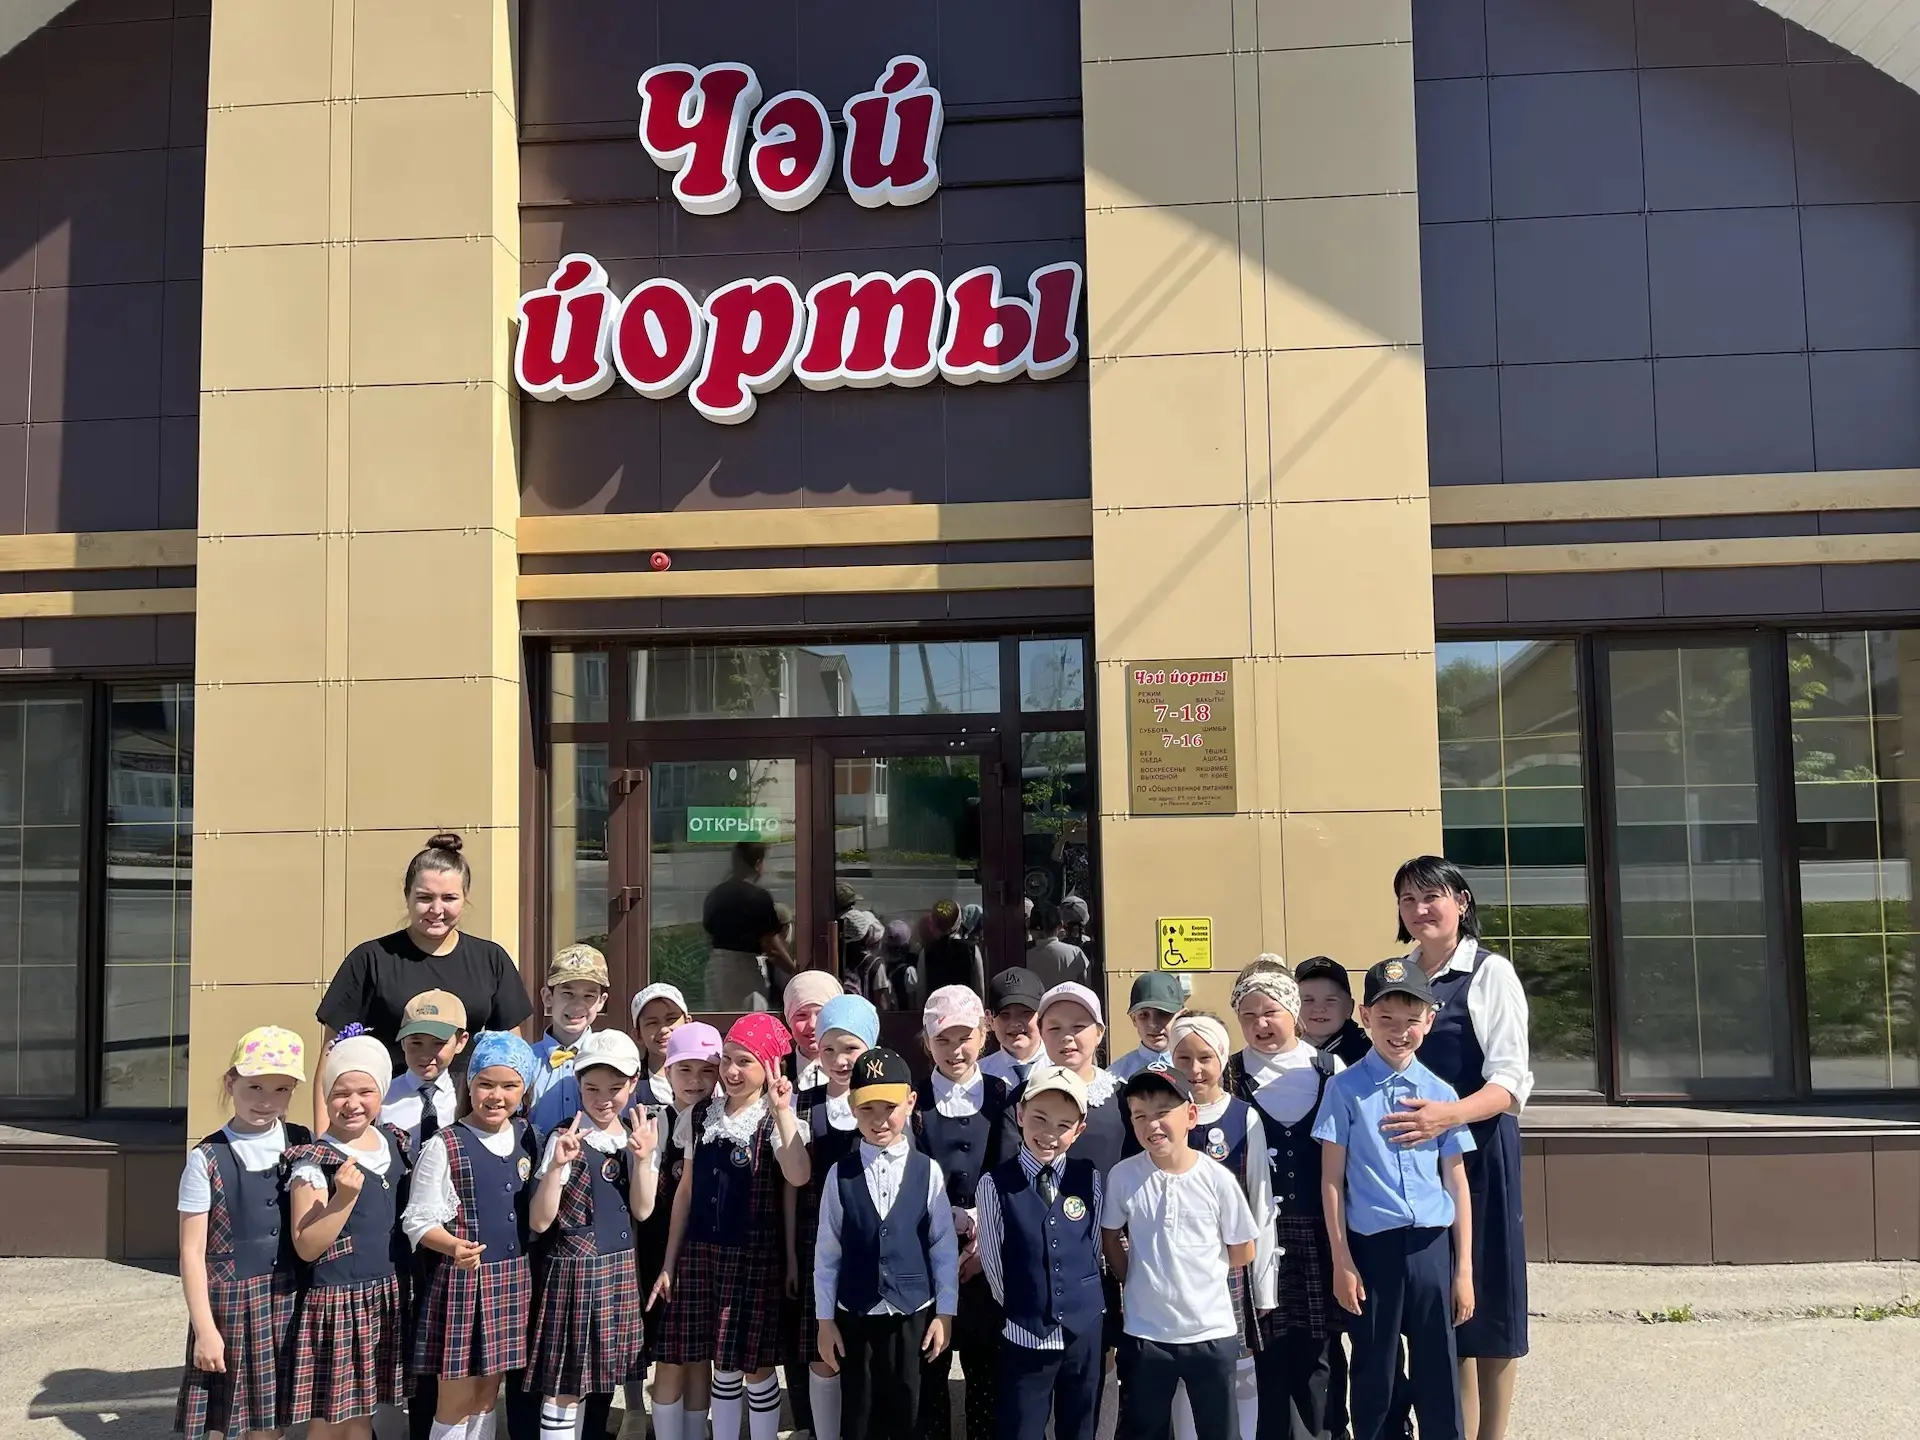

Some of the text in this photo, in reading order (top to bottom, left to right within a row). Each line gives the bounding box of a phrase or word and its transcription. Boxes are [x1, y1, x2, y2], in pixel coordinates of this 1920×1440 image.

[637, 54, 944, 215] Чәй
[514, 252, 1083, 425] йорты
[1134, 669, 1228, 686] Чәй йорты
[1154, 704, 1211, 722] 7-18
[1162, 734, 1204, 748] 7-16
[1140, 773, 1178, 781] ВЫХОДНОЙ
[1136, 785, 1147, 793] ПО
[689, 817, 779, 832] ОТКРЫТО
[866, 1058, 884, 1079] NY
